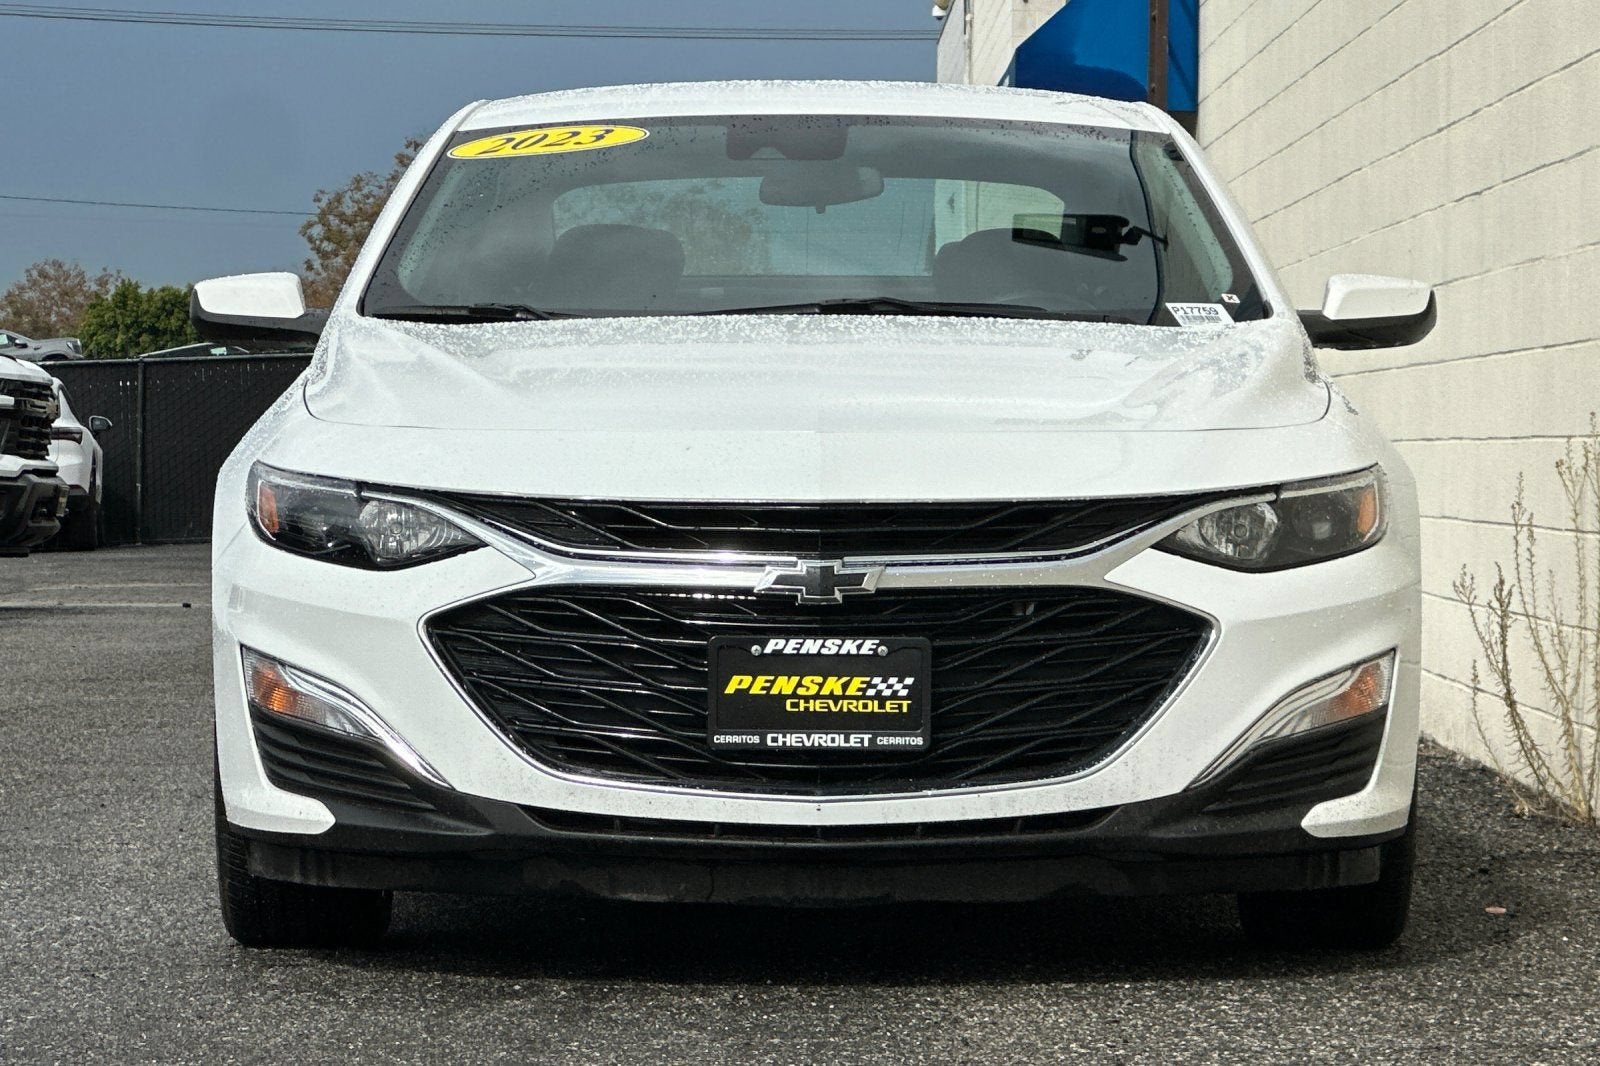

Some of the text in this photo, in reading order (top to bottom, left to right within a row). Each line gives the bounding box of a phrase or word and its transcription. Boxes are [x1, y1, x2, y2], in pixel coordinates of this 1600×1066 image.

[476, 129, 614, 155] 2023
[1171, 306, 1219, 315] P17759
[763, 639, 880, 655] PENSKE
[724, 675, 871, 696] PENSKE
[785, 699, 912, 713] CHEVROLET
[714, 733, 924, 747] CERRITOS CHEVROLET CERRITOS
